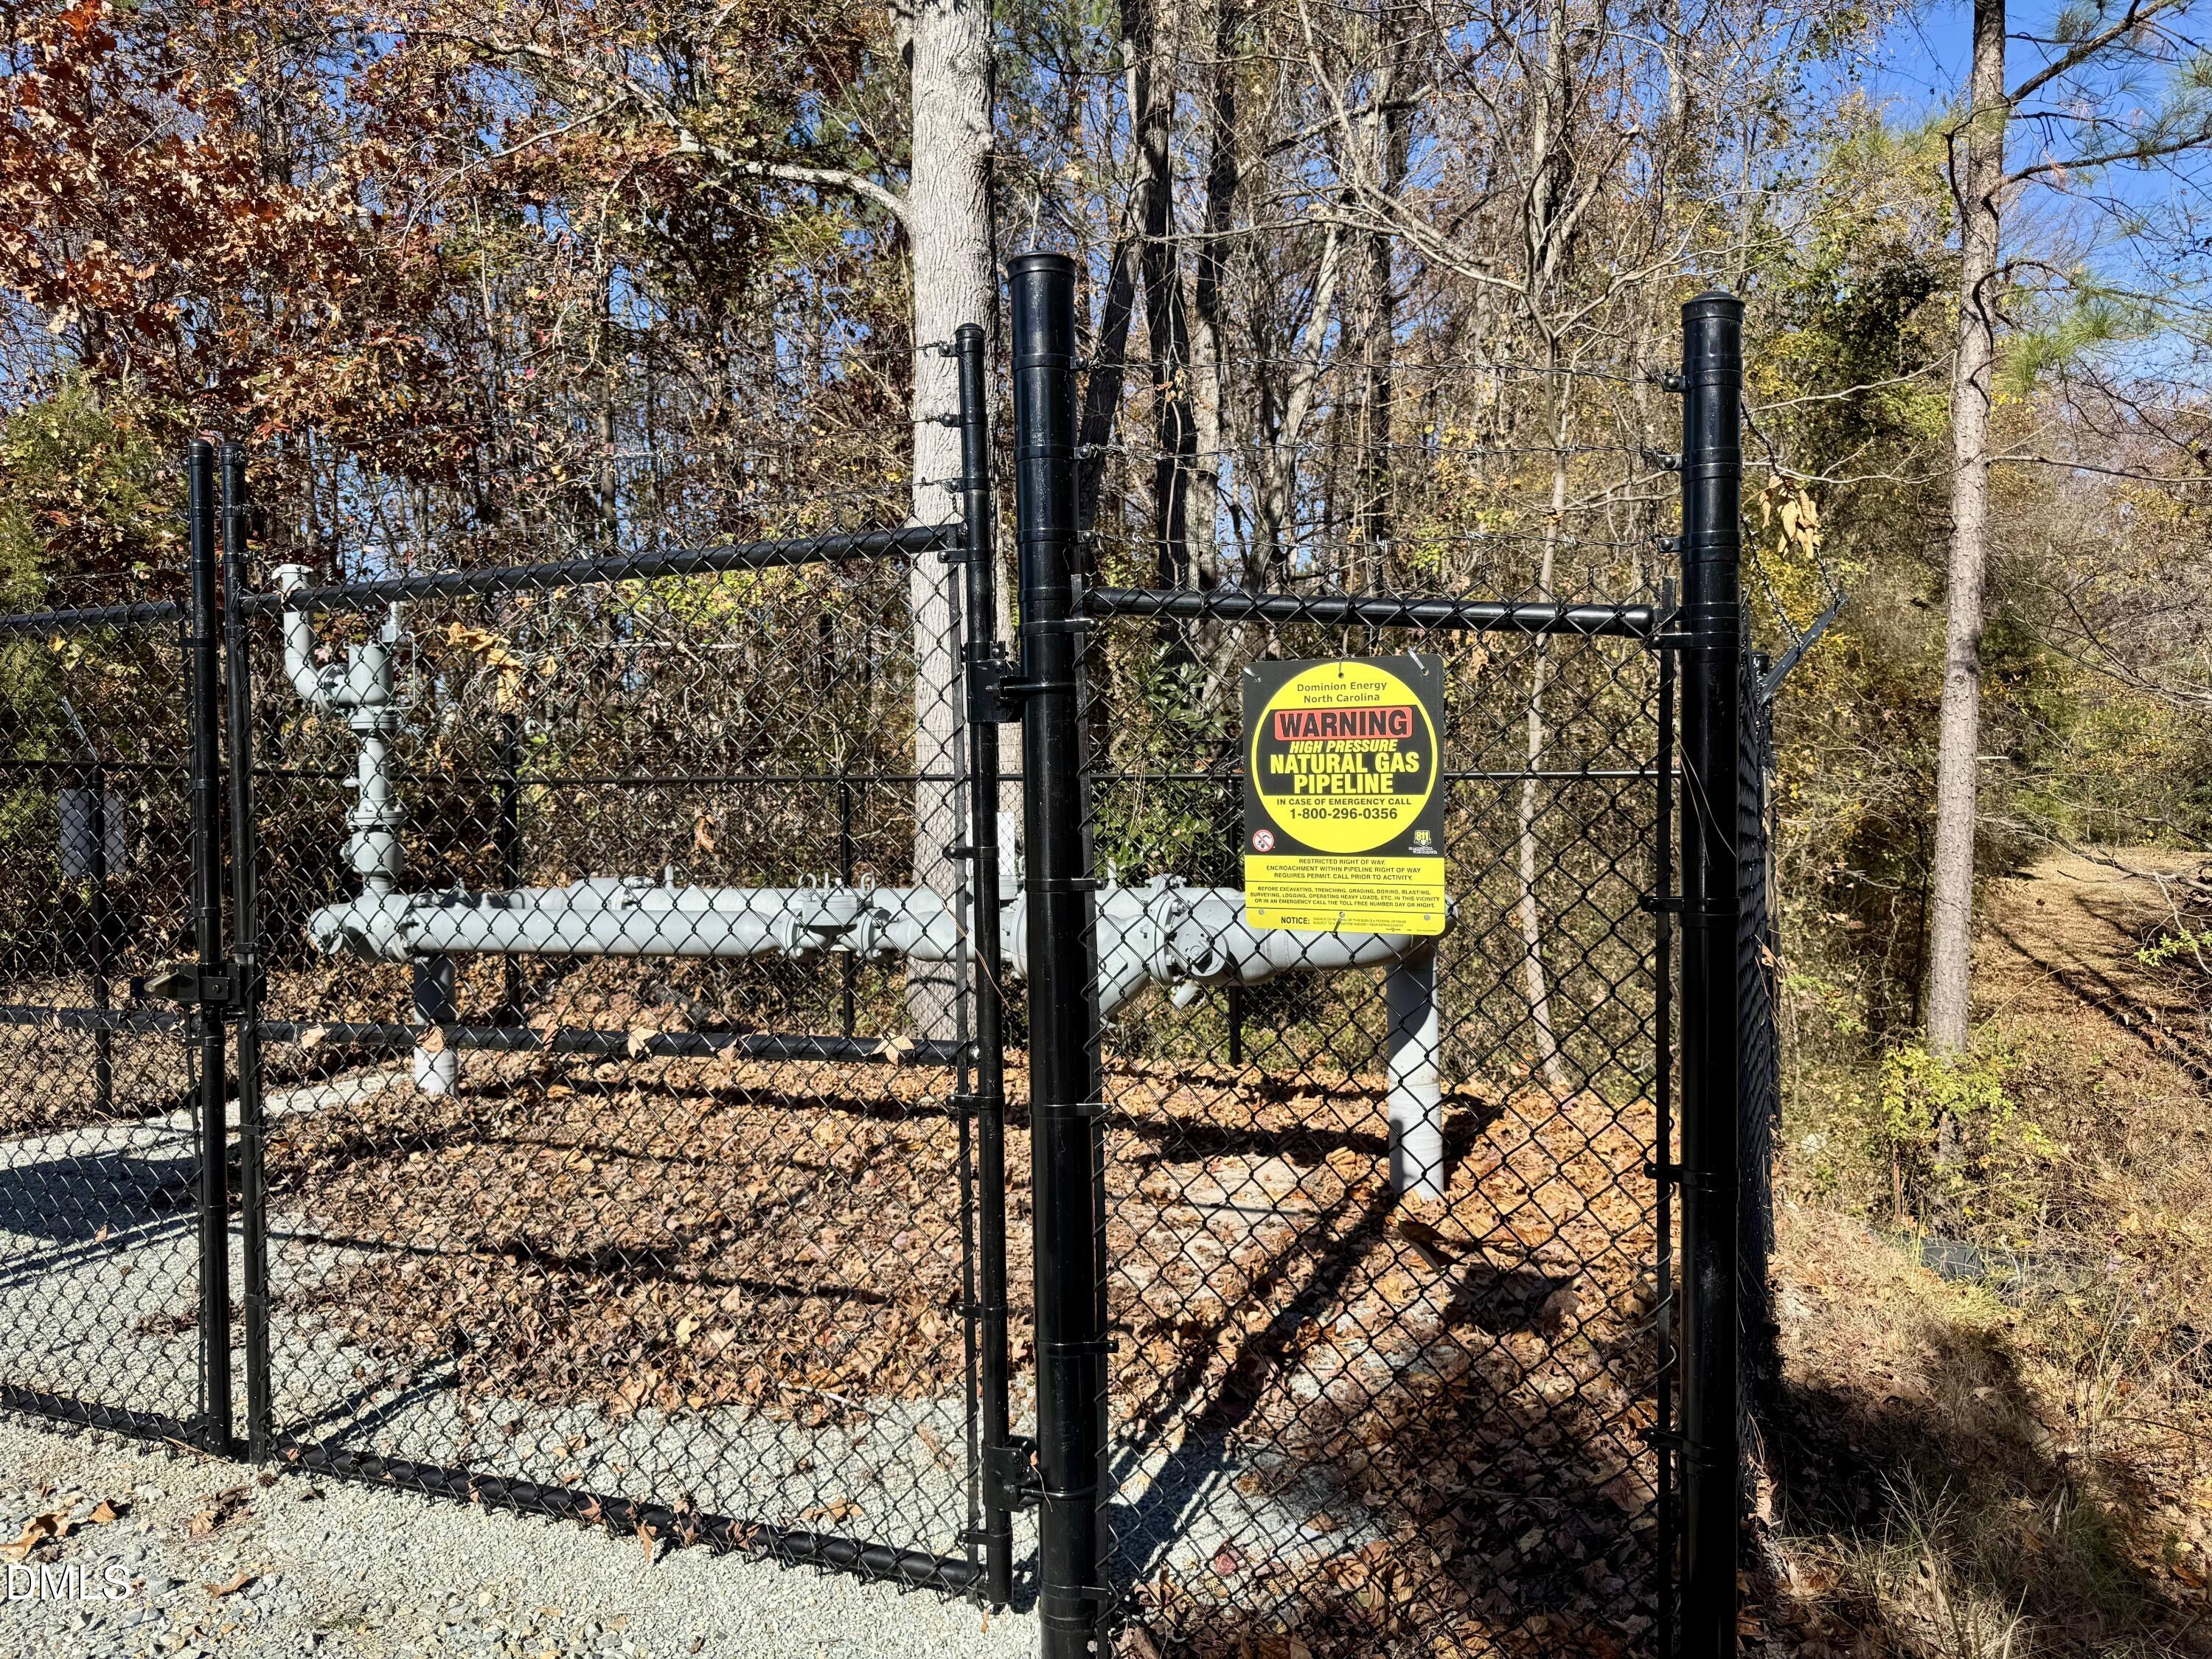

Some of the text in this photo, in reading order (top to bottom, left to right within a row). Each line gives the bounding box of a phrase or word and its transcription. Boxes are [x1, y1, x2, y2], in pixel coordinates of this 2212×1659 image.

[1297, 681, 1387, 692] Dominion Energy
[1304, 693, 1380, 703] North Carolina
[1279, 709, 1408, 737] WARNING
[1290, 739, 1398, 754] HIGH PRESSURE
[1270, 751, 1419, 774] NATURAL GAS
[1294, 773, 1394, 794] PIPELINE
[1290, 807, 1398, 819] 1-800-296-0356
[1416, 831, 1429, 841] 811
[1281, 917, 1310, 925] NOTICE:
